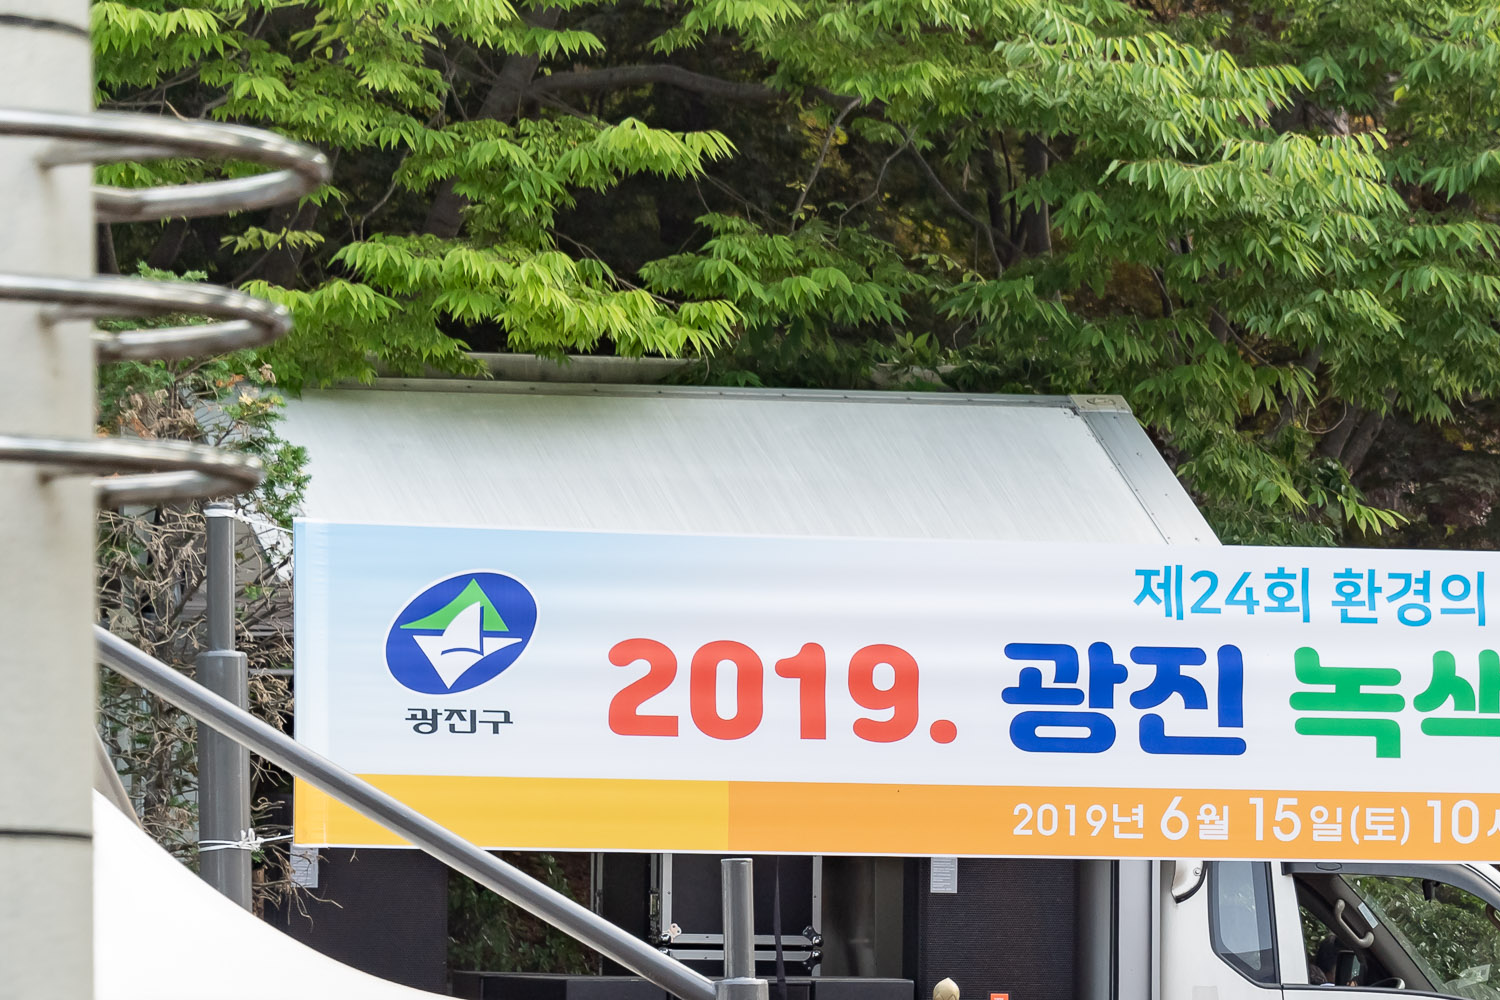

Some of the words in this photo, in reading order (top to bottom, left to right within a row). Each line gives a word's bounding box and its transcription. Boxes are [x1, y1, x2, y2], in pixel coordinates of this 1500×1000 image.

[1134, 565, 1310, 623] 제24회
[1332, 568, 1486, 627] 환경의
[406, 708, 513, 735] 광진구
[609, 638, 957, 744] 2019.
[1002, 642, 1246, 755] 광진
[1014, 803, 1144, 838] 2019년
[1161, 797, 1229, 840] 6월
[1250, 798, 1410, 846] 15일(토)
